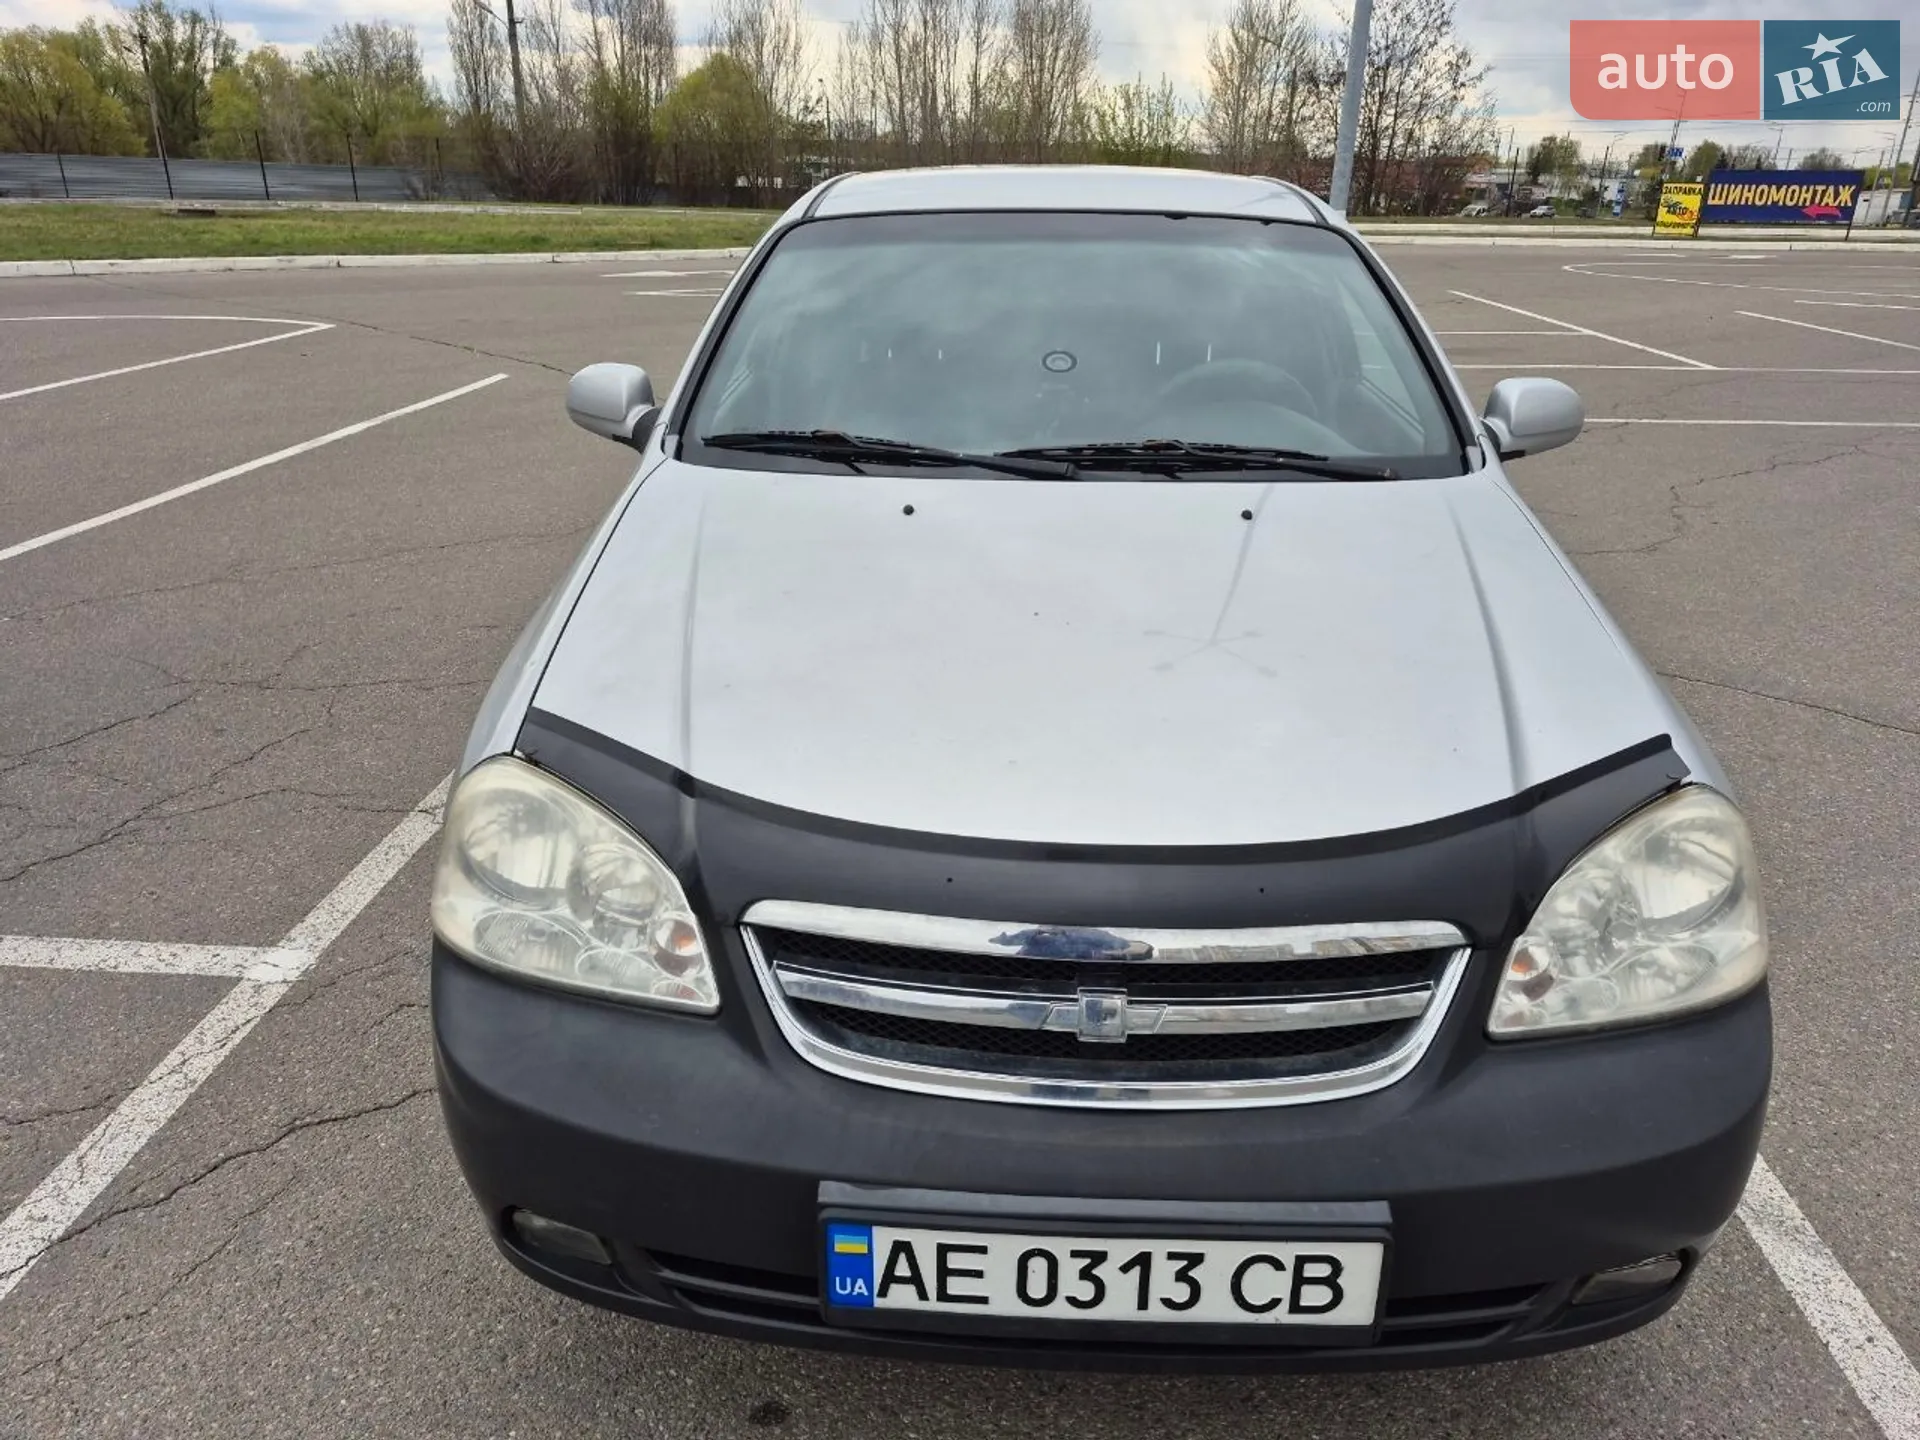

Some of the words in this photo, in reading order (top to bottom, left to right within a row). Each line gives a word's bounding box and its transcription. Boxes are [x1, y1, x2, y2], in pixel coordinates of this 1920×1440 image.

[1707, 183, 1856, 207] ШИНОМОНТАЖ
[835, 1277, 869, 1297] UA
[876, 1239, 990, 1305] AE
[1015, 1247, 1205, 1312] 0313
[1229, 1254, 1344, 1315] CB
